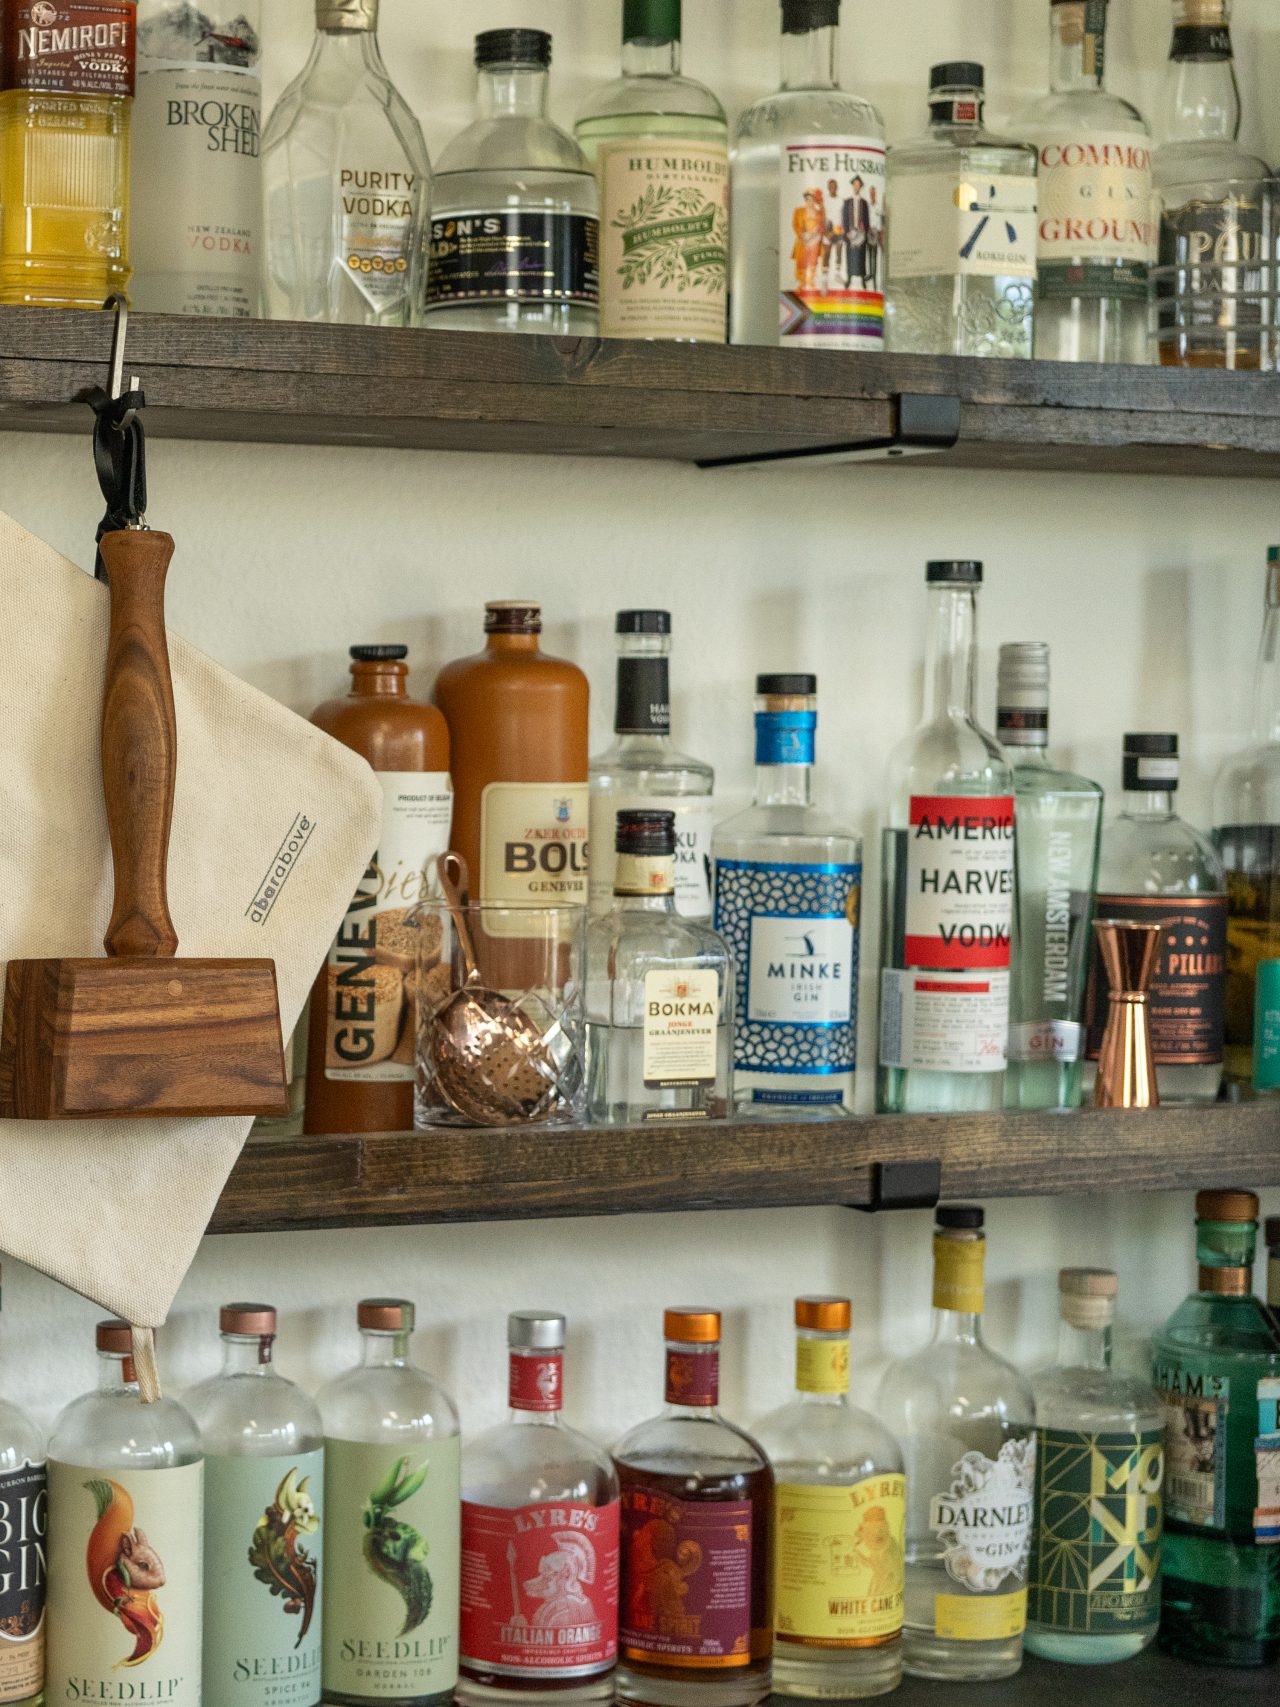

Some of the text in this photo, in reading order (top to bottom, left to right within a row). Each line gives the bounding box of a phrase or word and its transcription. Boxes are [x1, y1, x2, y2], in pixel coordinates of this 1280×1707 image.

[79, 61, 129, 73] VODKA
[166, 100, 260, 132] BROKEN
[788, 153, 830, 173] FIVE
[834, 153, 885, 177] HUSBA
[1040, 144, 1151, 170] COMMO
[341, 170, 415, 191] PURITY
[343, 197, 413, 217] VODKA
[1040, 217, 1148, 246] GROUN
[188, 236, 251, 254] VODKA
[976, 249, 1027, 262] ROKU GIN
[250, 815, 310, 923] abarabove
[938, 922, 1010, 948] VODK
[1042, 875, 1071, 1002] AMSTERDAM
[767, 962, 841, 980] MINKE
[793, 992, 820, 1002] GIN
[649, 1001, 715, 1017] BOKMA
[1029, 1035, 1065, 1050] GIN
[850, 1479, 904, 1508] LYRE
[513, 1508, 599, 1533] LYRE'S
[828, 1597, 894, 1616] WHITE CANE
[500, 1624, 602, 1646] ITALIAN ORANGE
[340, 1636, 447, 1662] SEEDLIP
[355, 1667, 408, 1678] GARDEN
[66, 1676, 176, 1701] SEEDLIP
[264, 1683, 297, 1695] SPICE
